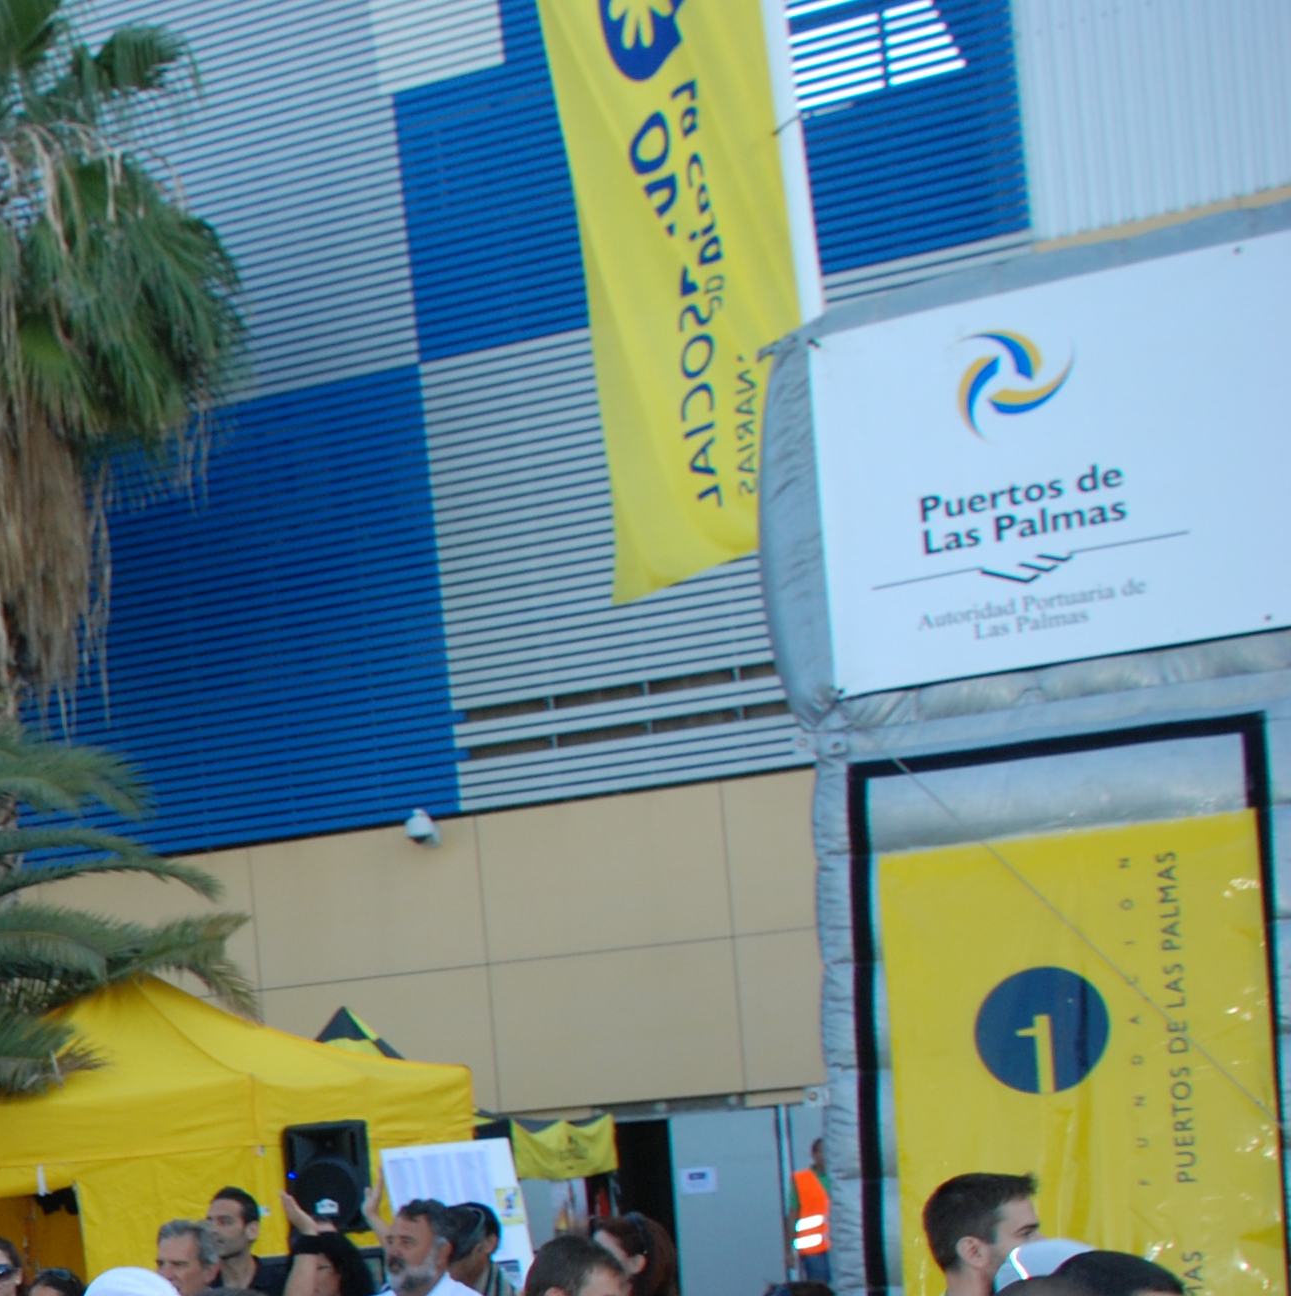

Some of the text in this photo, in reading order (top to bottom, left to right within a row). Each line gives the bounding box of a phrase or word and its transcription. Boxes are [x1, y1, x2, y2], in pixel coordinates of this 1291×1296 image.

[918, 463, 1125, 523] Puertos de
[922, 500, 1129, 555] Las Palmas
[917, 577, 1148, 631] Autoridad Portuaria de
[973, 608, 1090, 641] Las Palmas
[1156, 851, 1198, 1184] PUERTOS DE LAS PALMAS
